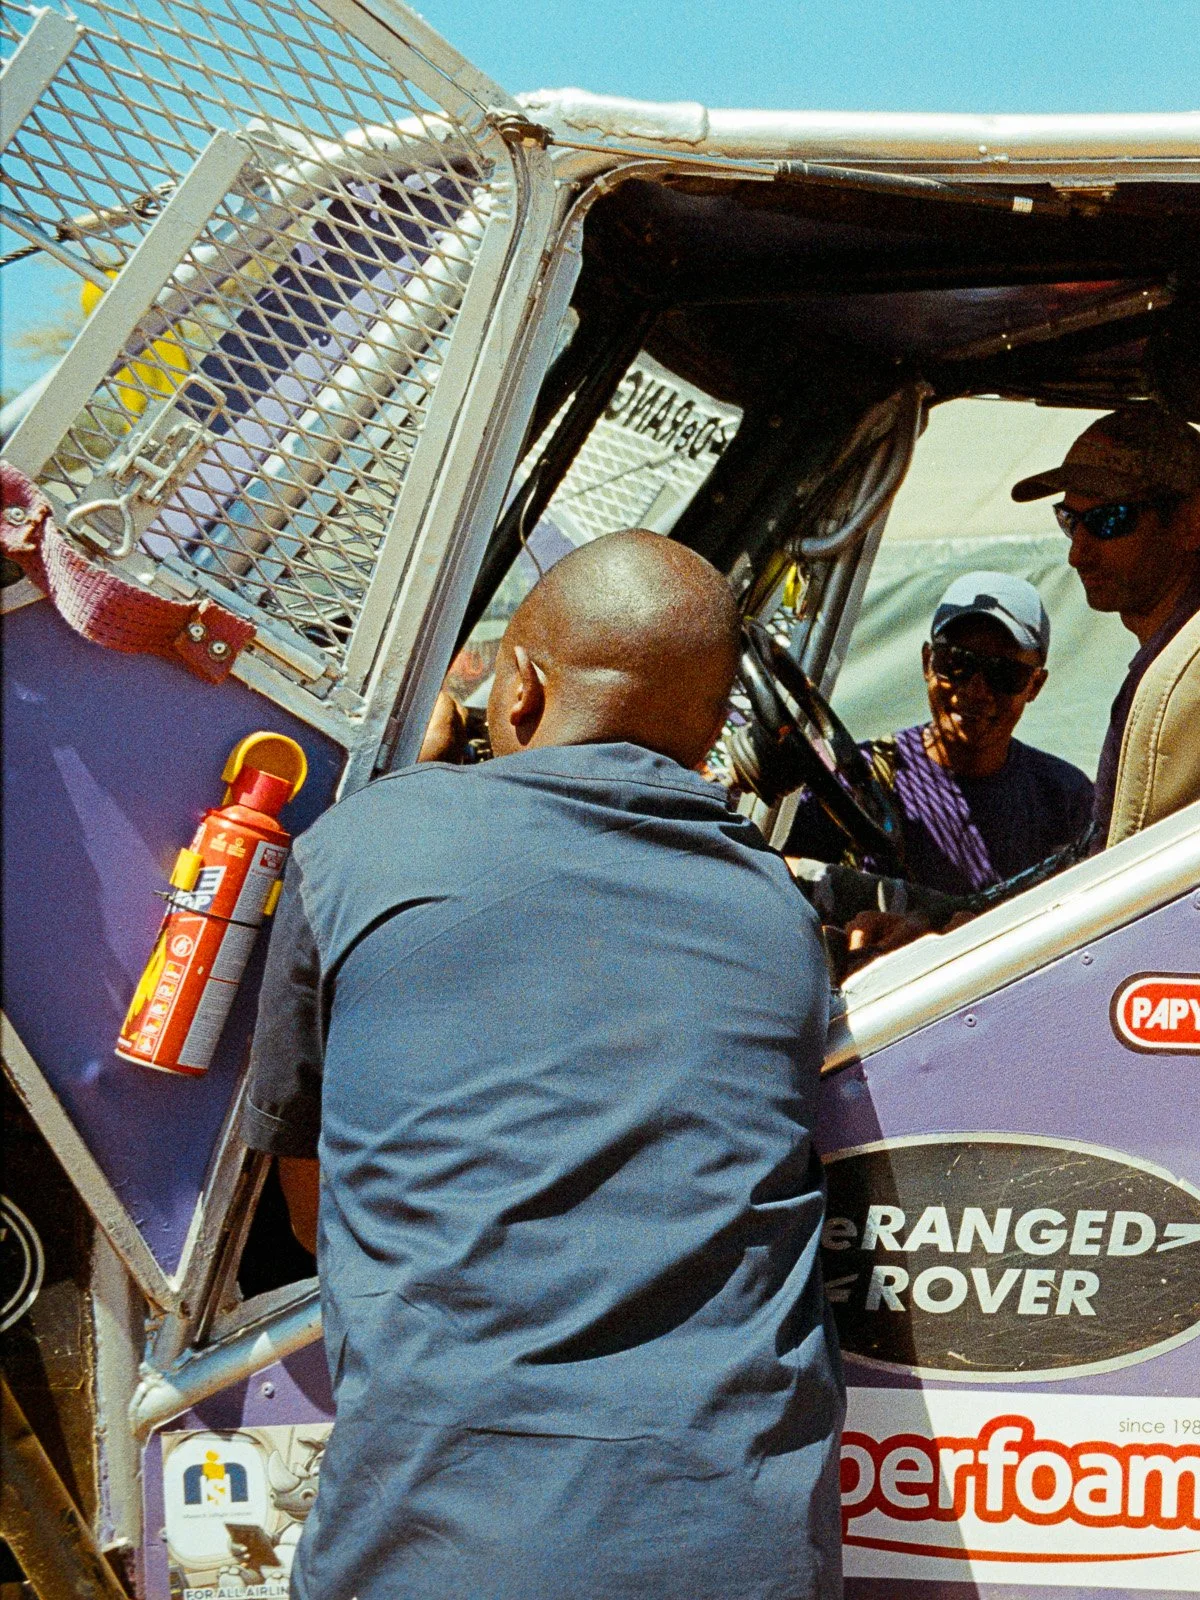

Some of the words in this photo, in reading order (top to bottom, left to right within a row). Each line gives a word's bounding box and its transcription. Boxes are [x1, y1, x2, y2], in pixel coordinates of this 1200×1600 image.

[865, 1265, 1100, 1316] ROVER
[1119, 1417, 1165, 1433] since
[185, 1589, 214, 1600] FOR
[218, 1588, 241, 1599] ALL
